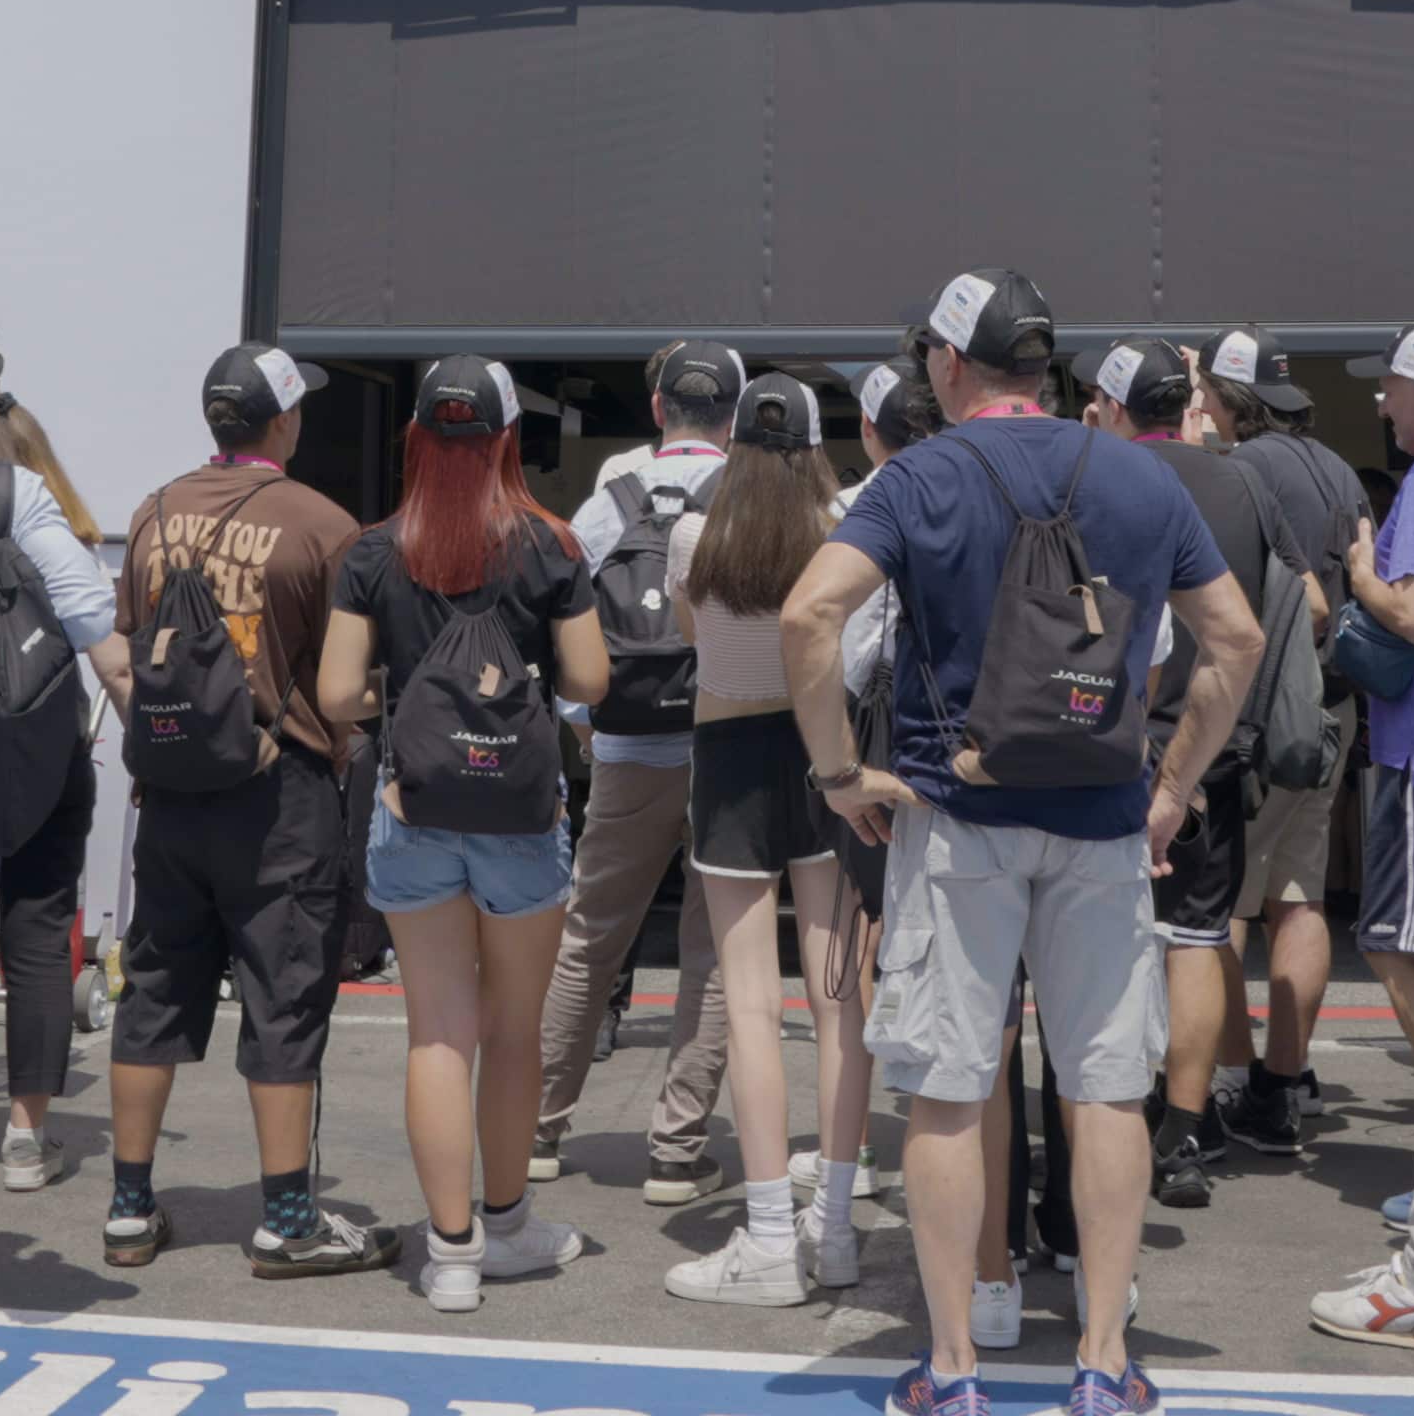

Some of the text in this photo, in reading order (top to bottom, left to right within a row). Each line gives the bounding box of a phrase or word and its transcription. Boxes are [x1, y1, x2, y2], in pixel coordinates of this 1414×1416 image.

[150, 513, 282, 566] LOVE YOU
[1050, 669, 1118, 689] JAGUA
[139, 701, 192, 713] JAGUAR
[1069, 686, 1105, 714] tcs
[150, 715, 180, 734] tcs
[450, 730, 519, 745] JAGUAR
[468, 745, 500, 768] tcs
